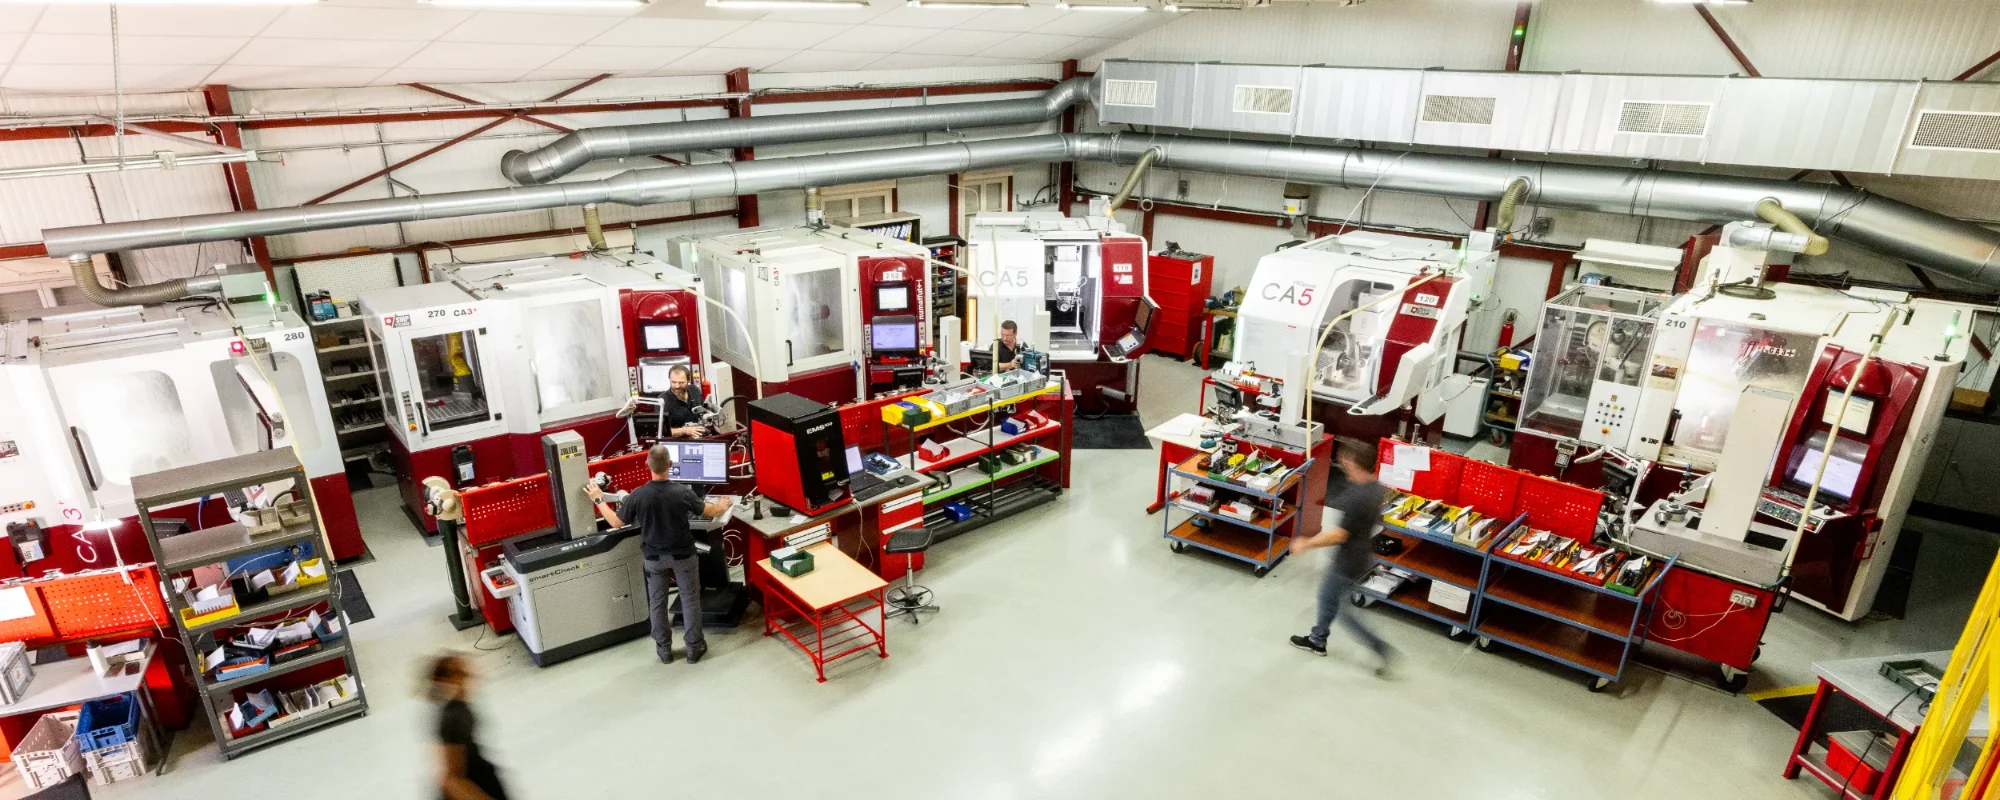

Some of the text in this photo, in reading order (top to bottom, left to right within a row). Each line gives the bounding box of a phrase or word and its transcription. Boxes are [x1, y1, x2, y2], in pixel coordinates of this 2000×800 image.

[979, 270, 1028, 287] CA5
[1262, 282, 1314, 306] CA5
[1419, 295, 1435, 304] 120
[428, 309, 446, 318] 270
[1665, 319, 1687, 329] 210
[284, 331, 305, 341] 280
[529, 564, 580, 583] smartCheck
